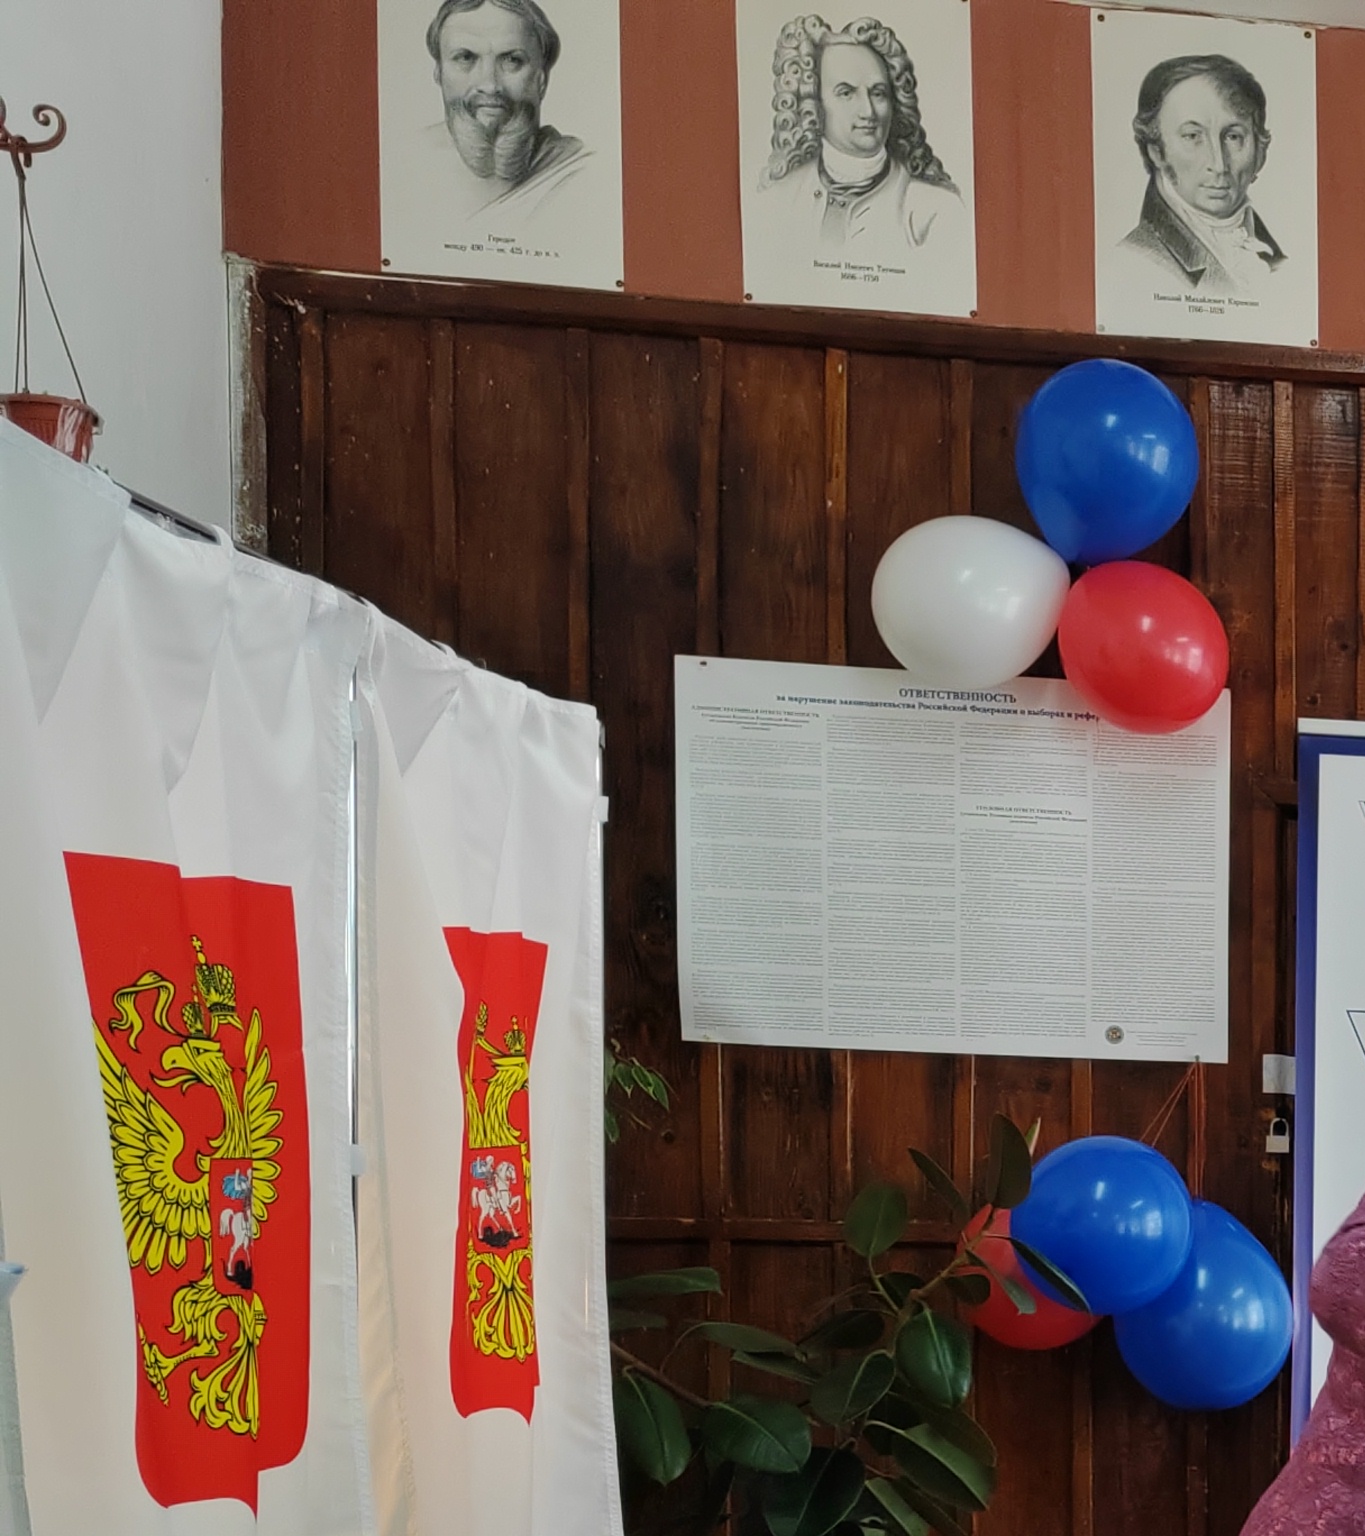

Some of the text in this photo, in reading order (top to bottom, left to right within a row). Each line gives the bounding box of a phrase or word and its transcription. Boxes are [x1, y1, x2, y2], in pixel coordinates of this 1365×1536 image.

[899, 688, 1017, 703] ОТВЕТСТВЕННОСТЬ
[788, 696, 838, 705] нарушение
[839, 699, 916, 710] законодательства
[918, 701, 967, 712] Российской
[969, 705, 1018, 717] Федерации
[1027, 708, 1065, 719] выборах
